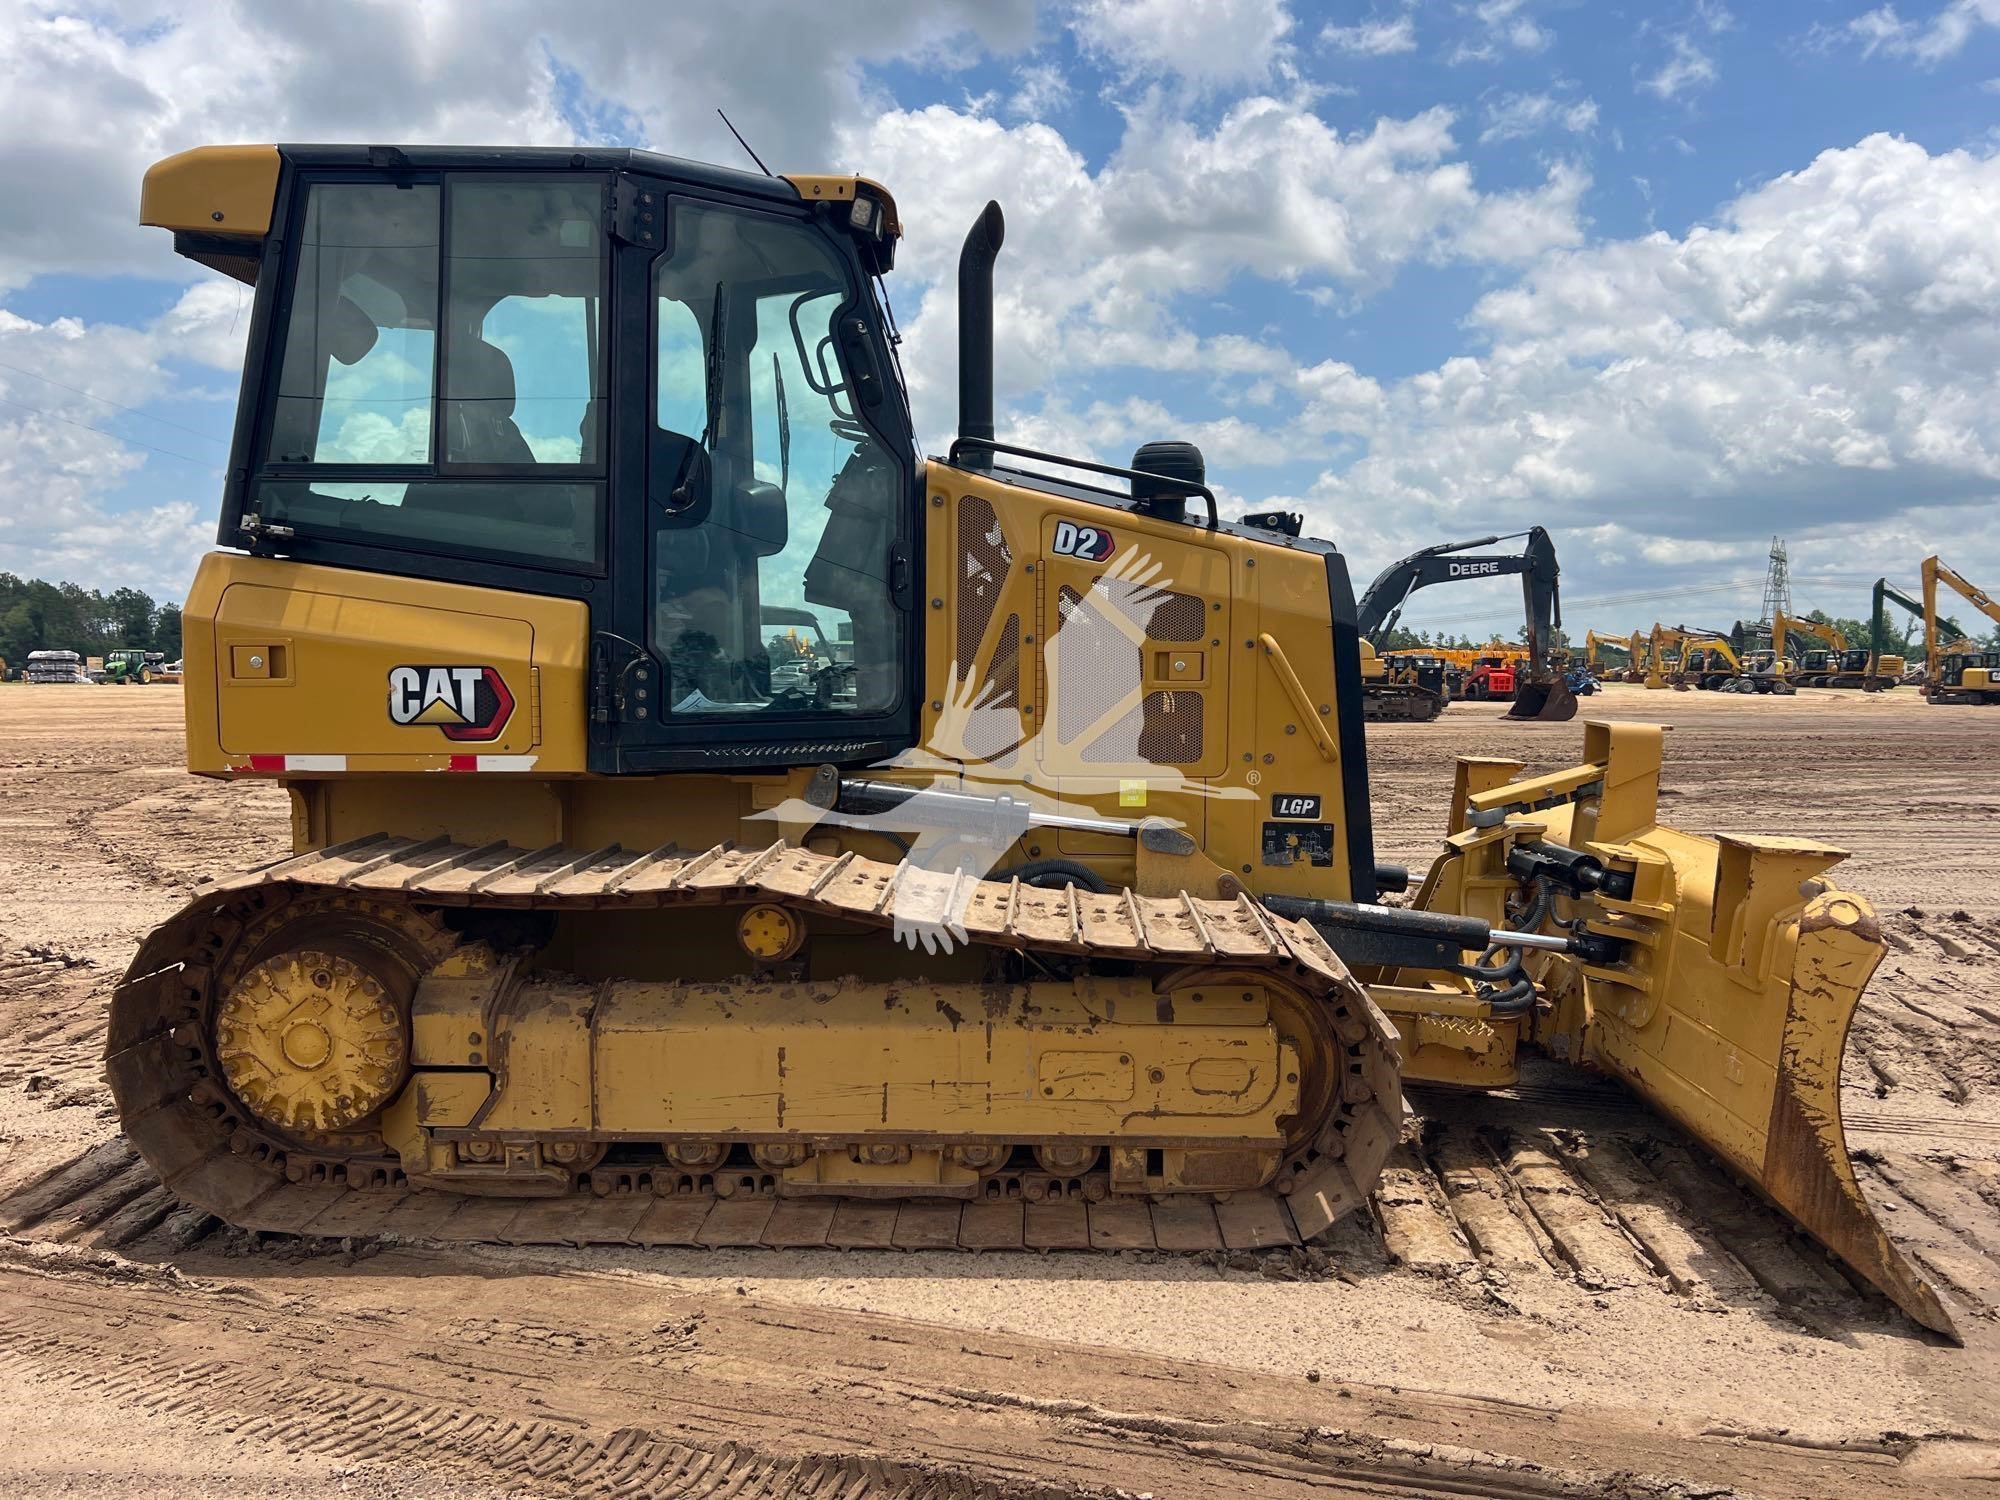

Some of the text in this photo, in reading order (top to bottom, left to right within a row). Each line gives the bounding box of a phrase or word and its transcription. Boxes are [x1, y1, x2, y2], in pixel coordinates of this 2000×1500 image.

[1053, 522, 1099, 560] D2
[1449, 561, 1499, 577] DEERE
[389, 667, 483, 724] CAT
[1279, 798, 1315, 815] LGP
